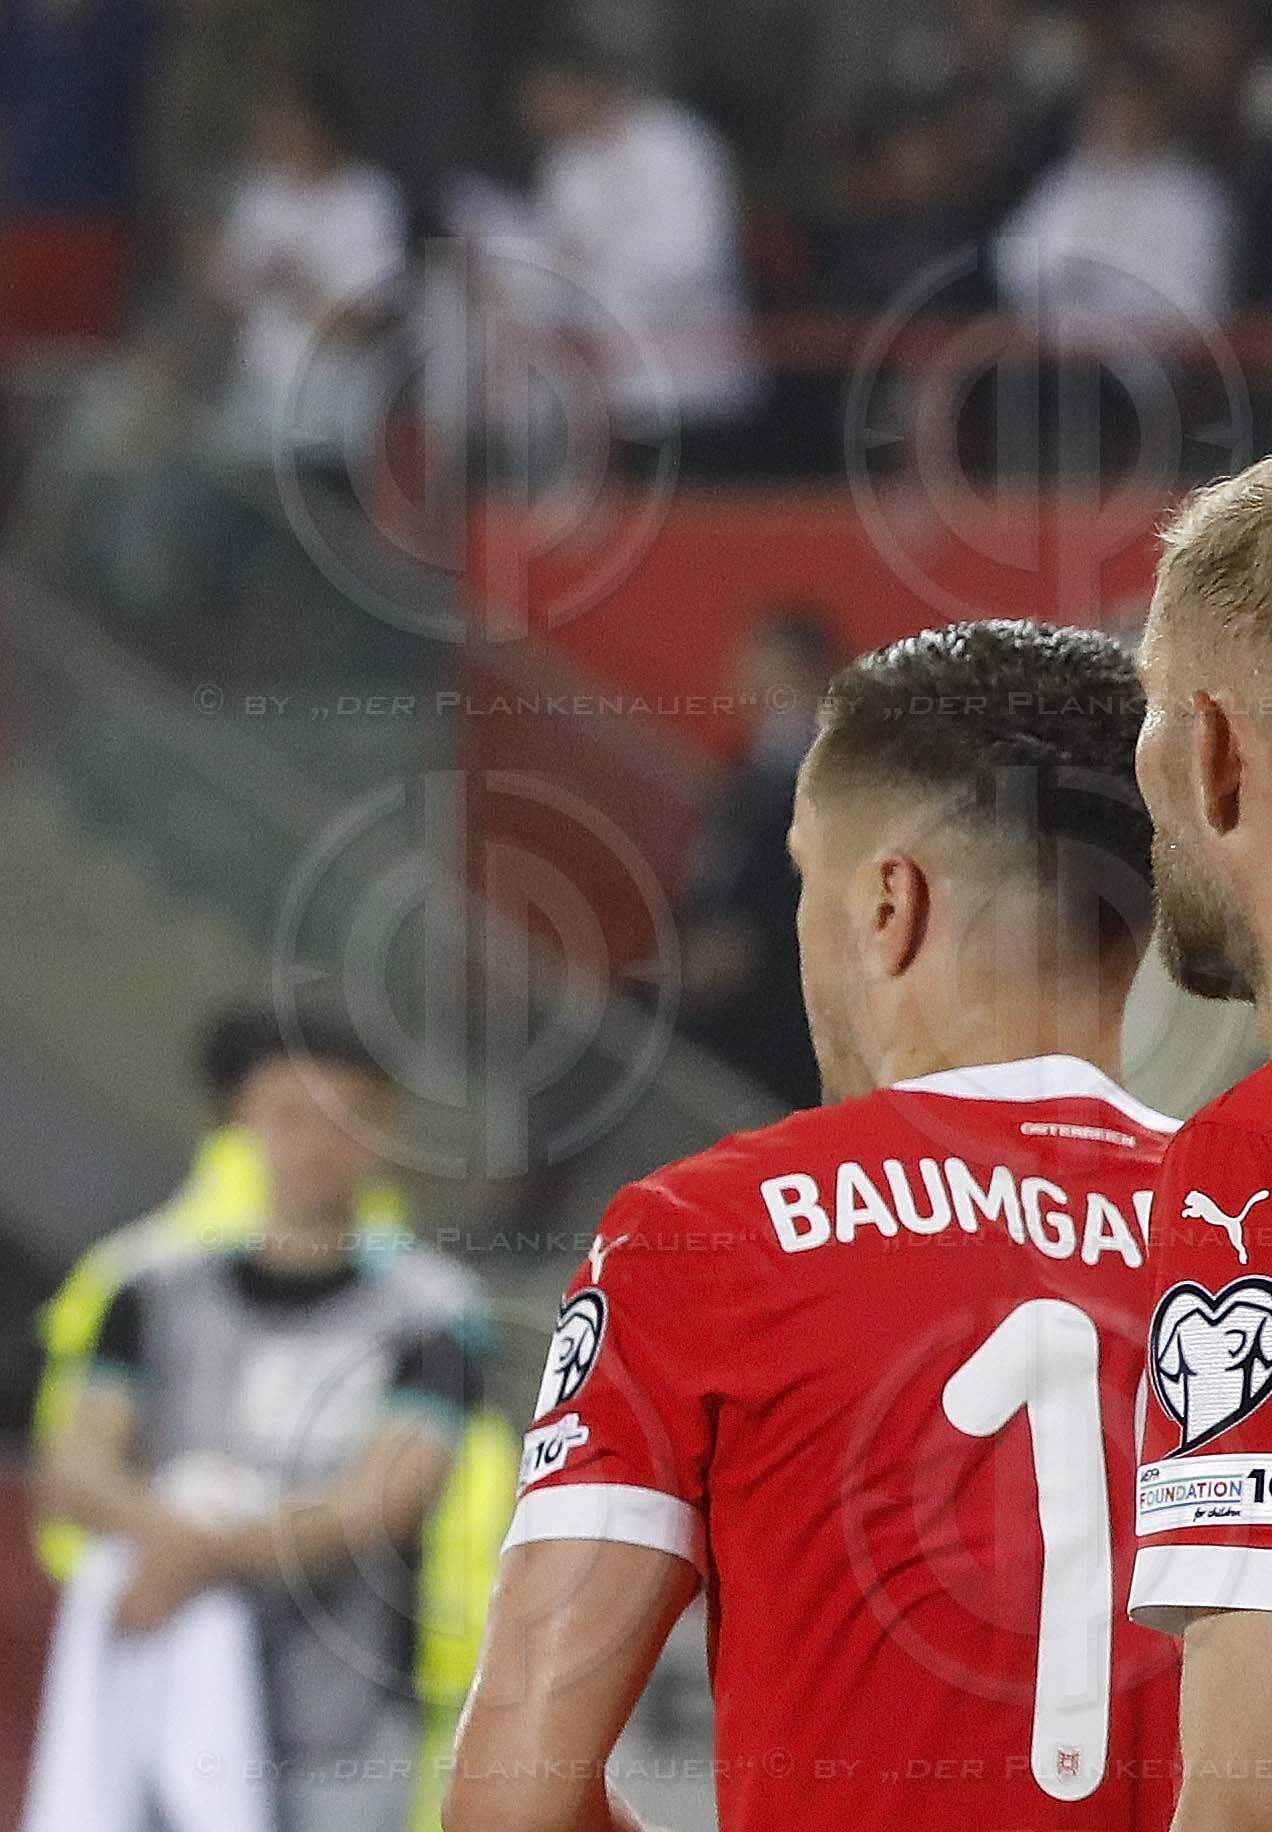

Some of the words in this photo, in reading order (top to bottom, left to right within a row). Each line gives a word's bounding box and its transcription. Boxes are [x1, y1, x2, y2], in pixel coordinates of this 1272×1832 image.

[760, 1157, 1154, 1268] BAUMGA
[943, 1299, 1148, 1801] 1
[1140, 1480, 1241, 1509] FOUNDATION
